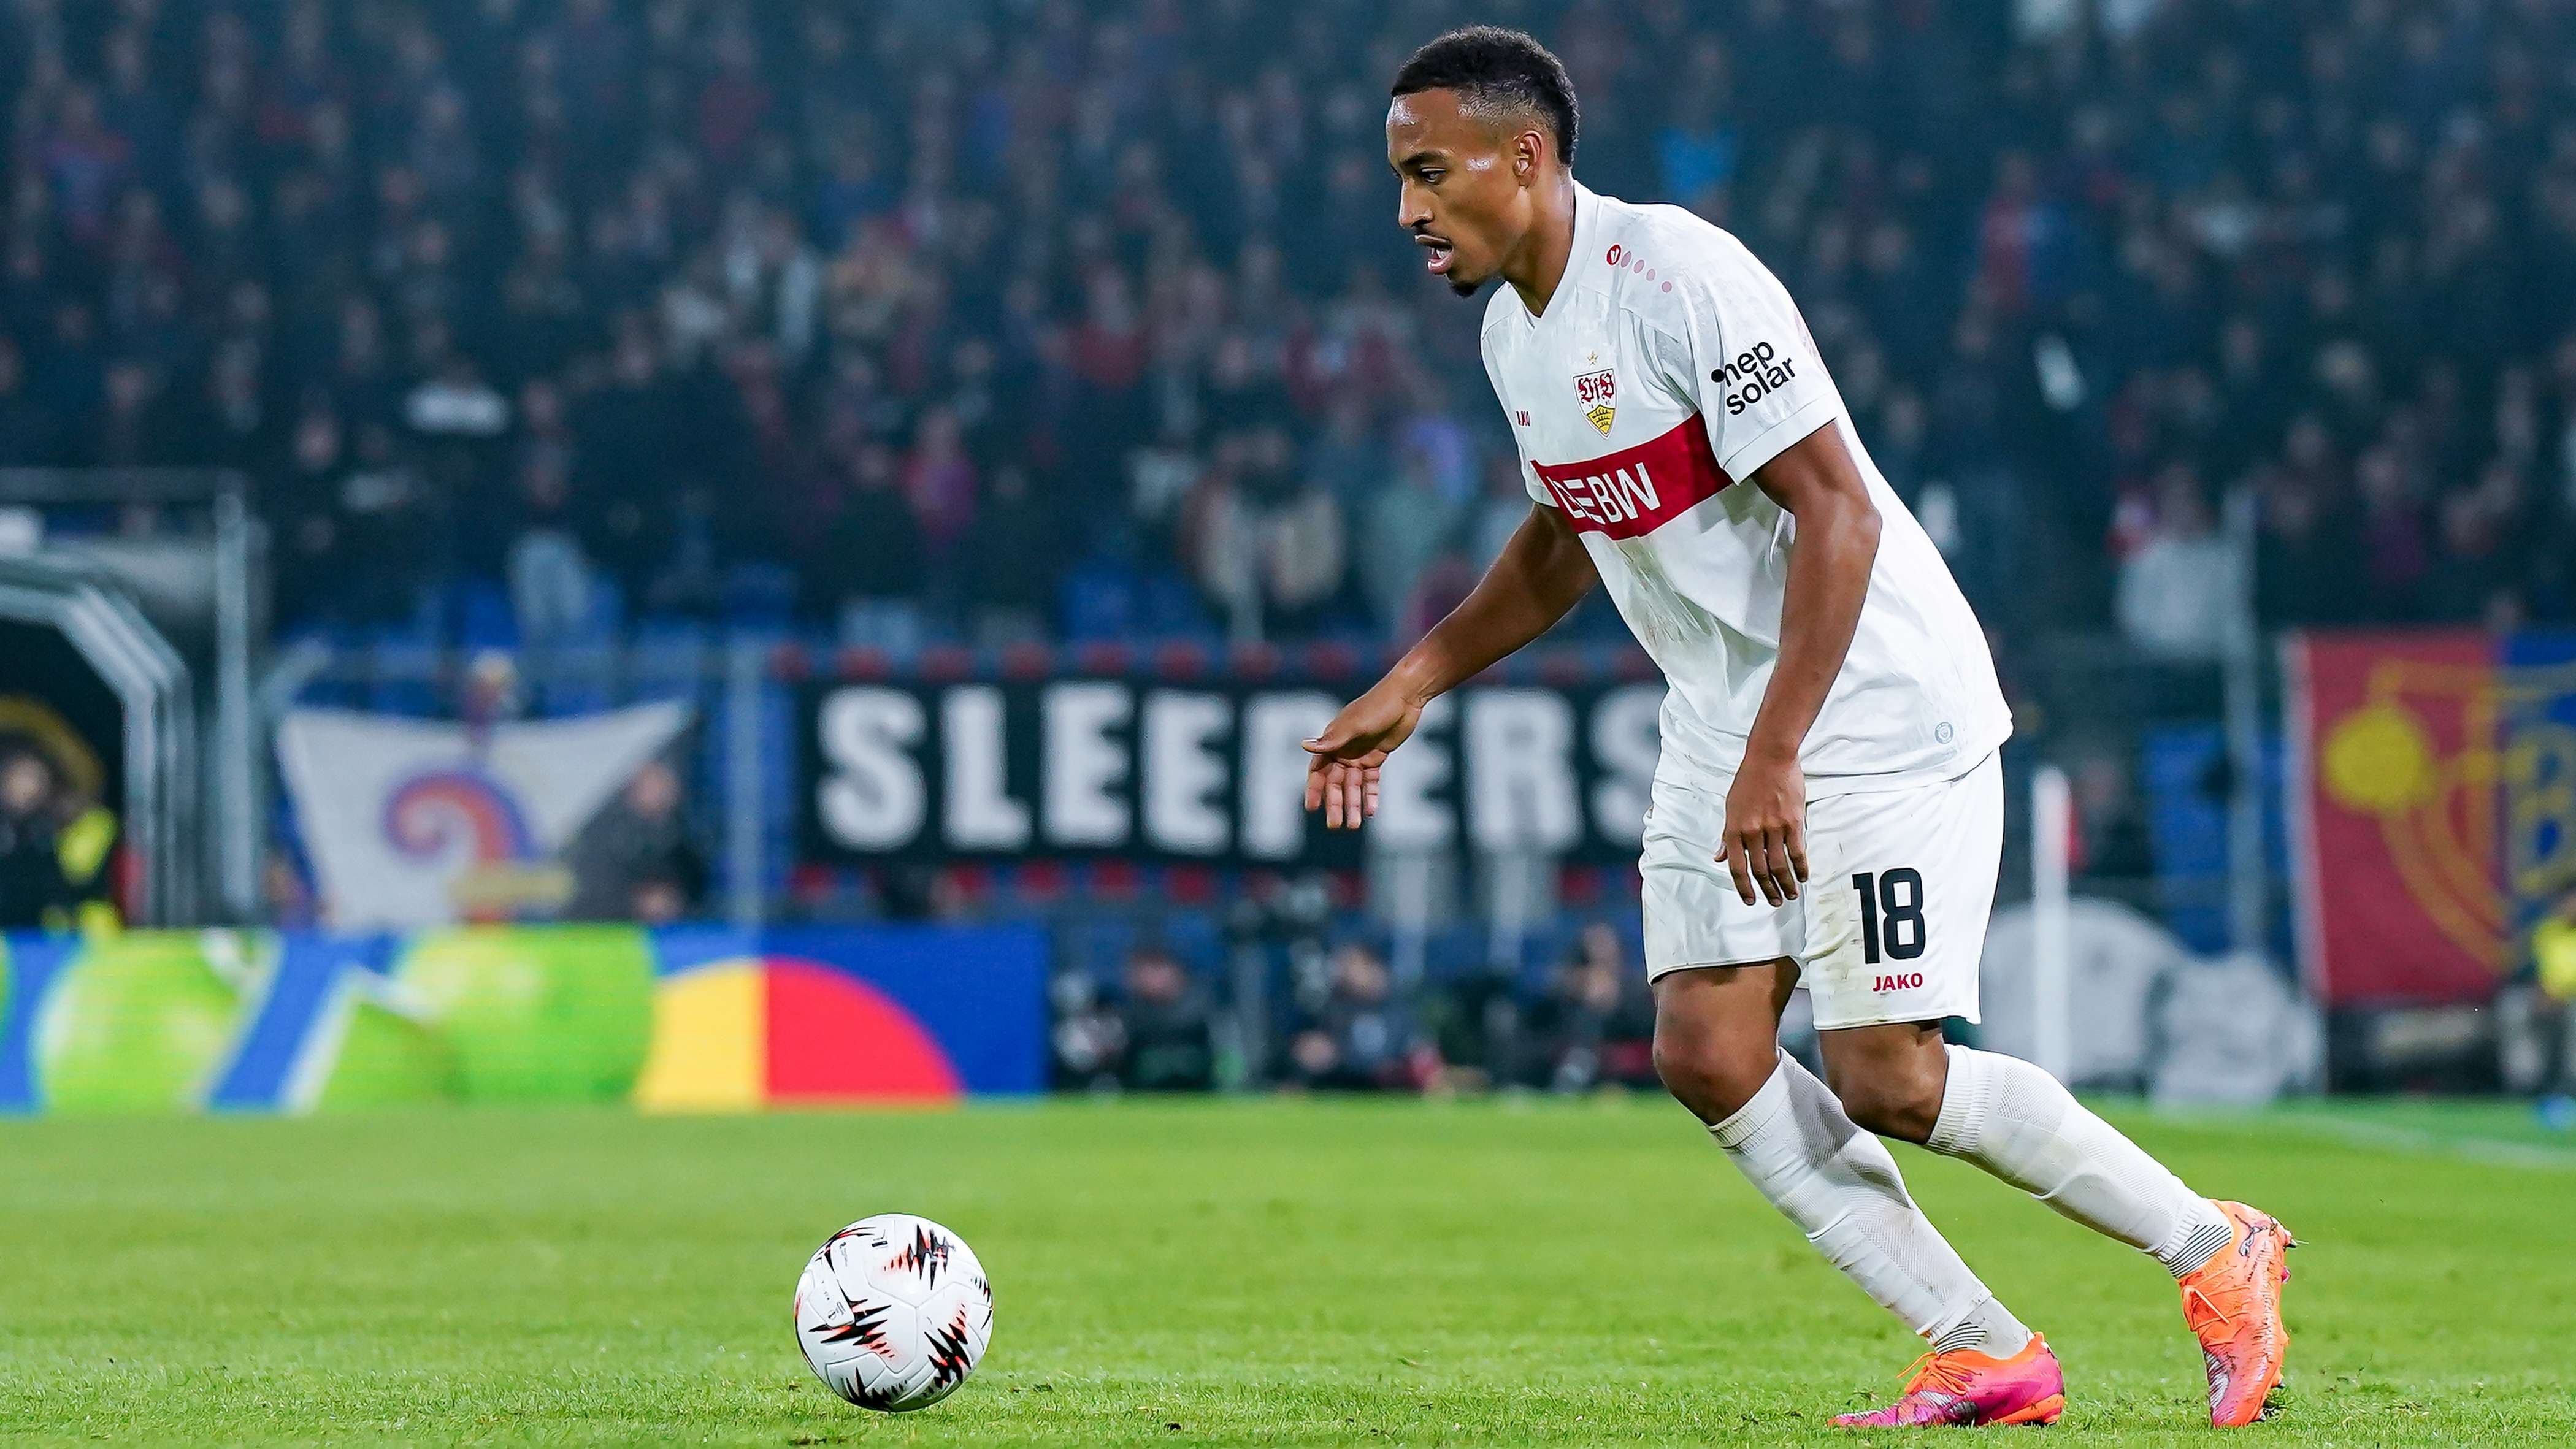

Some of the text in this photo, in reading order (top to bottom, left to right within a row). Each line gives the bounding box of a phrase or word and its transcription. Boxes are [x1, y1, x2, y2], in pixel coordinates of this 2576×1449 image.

[1714, 342, 1774, 388] nep
[1726, 357, 1796, 415] solar
[1852, 868, 1926, 964] 18
[1873, 973, 1923, 992] JAKO
